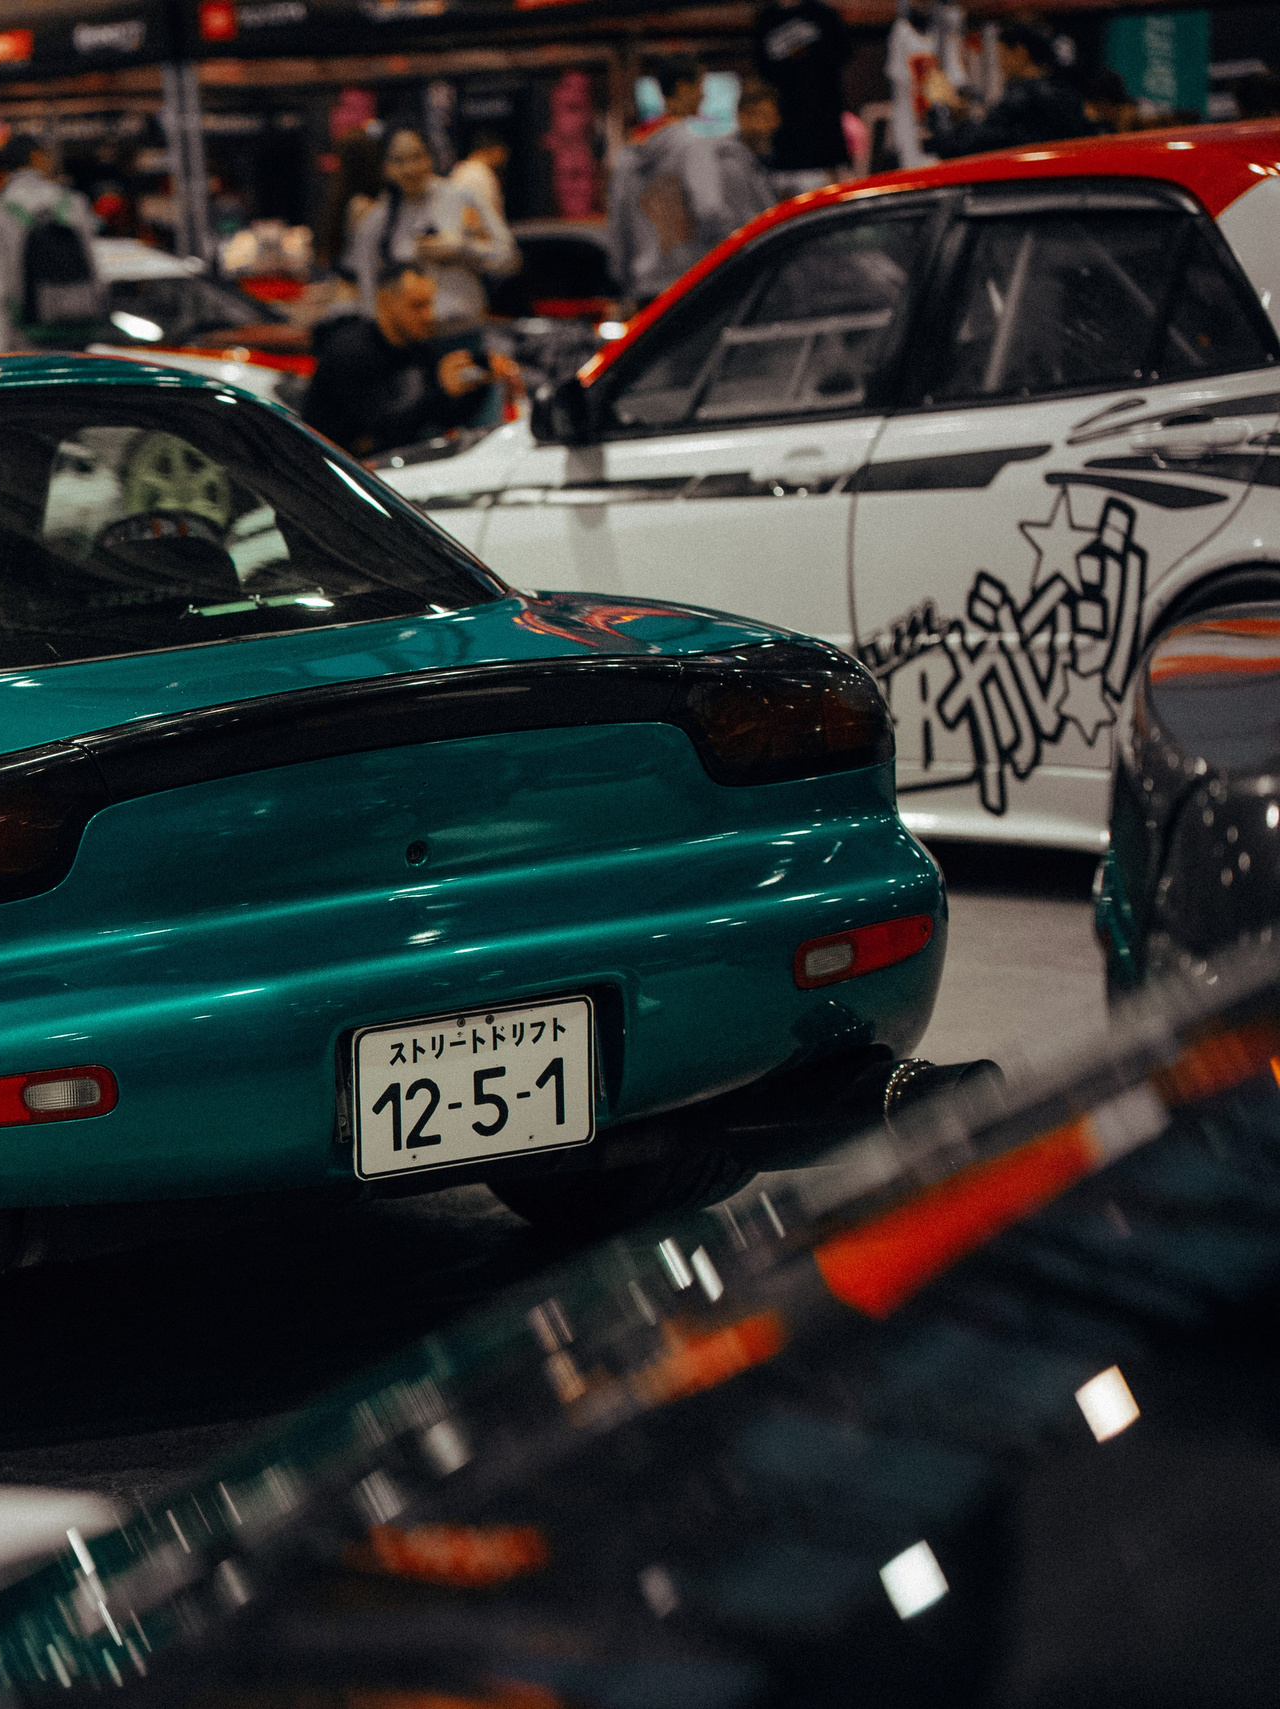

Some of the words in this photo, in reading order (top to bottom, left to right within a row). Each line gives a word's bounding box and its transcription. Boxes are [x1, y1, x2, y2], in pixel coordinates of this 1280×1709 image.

[389, 1017, 566, 1066] ストリートドリフト
[372, 1057, 565, 1151] 12-5-1
